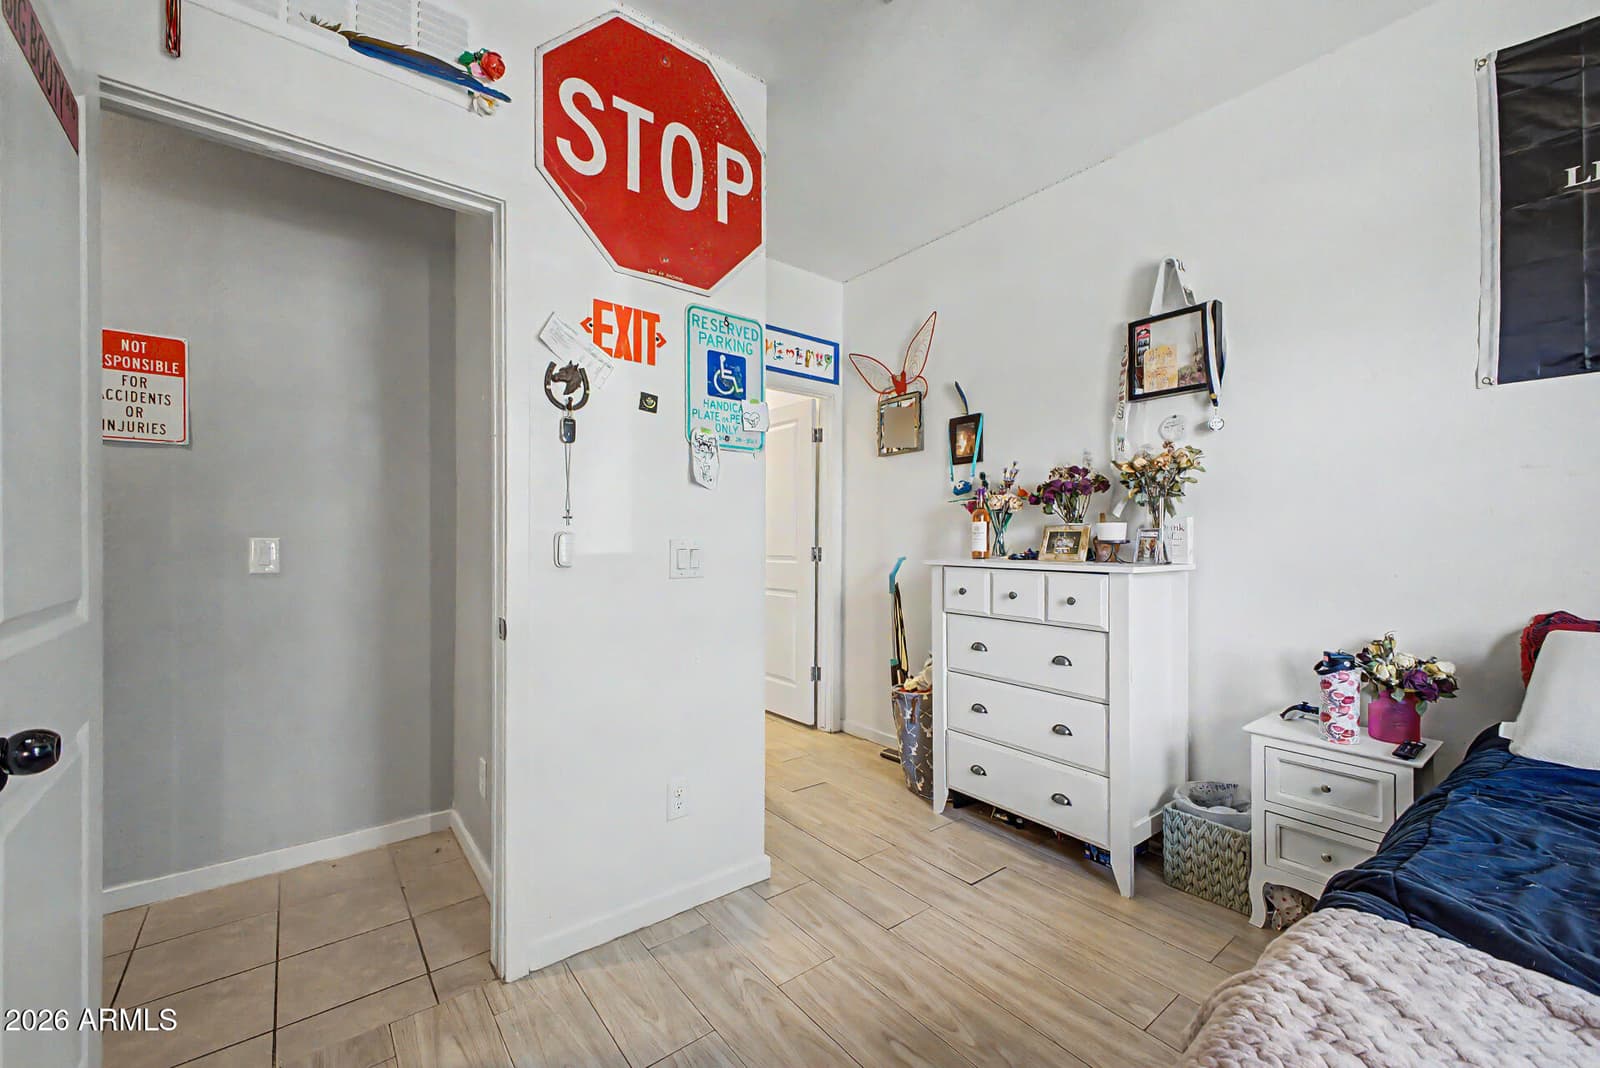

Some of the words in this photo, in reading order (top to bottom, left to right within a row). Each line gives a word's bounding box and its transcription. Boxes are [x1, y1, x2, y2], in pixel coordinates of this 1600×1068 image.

[556, 77, 754, 224] STOP
[593, 298, 661, 366] EXIT
[692, 313, 759, 342] RESERVED
[121, 339, 147, 354] NOT
[699, 331, 753, 356] PARKING
[102, 353, 180, 375] SPONSIBLE
[122, 375, 148, 389] FOR
[102, 388, 172, 406] CCIDENTS
[125, 405, 144, 419] OR
[692, 408, 721, 421] PLATE
[703, 399, 743, 413] HANDICA
[102, 418, 167, 435] INJURIES
[715, 423, 739, 435] ONLY
